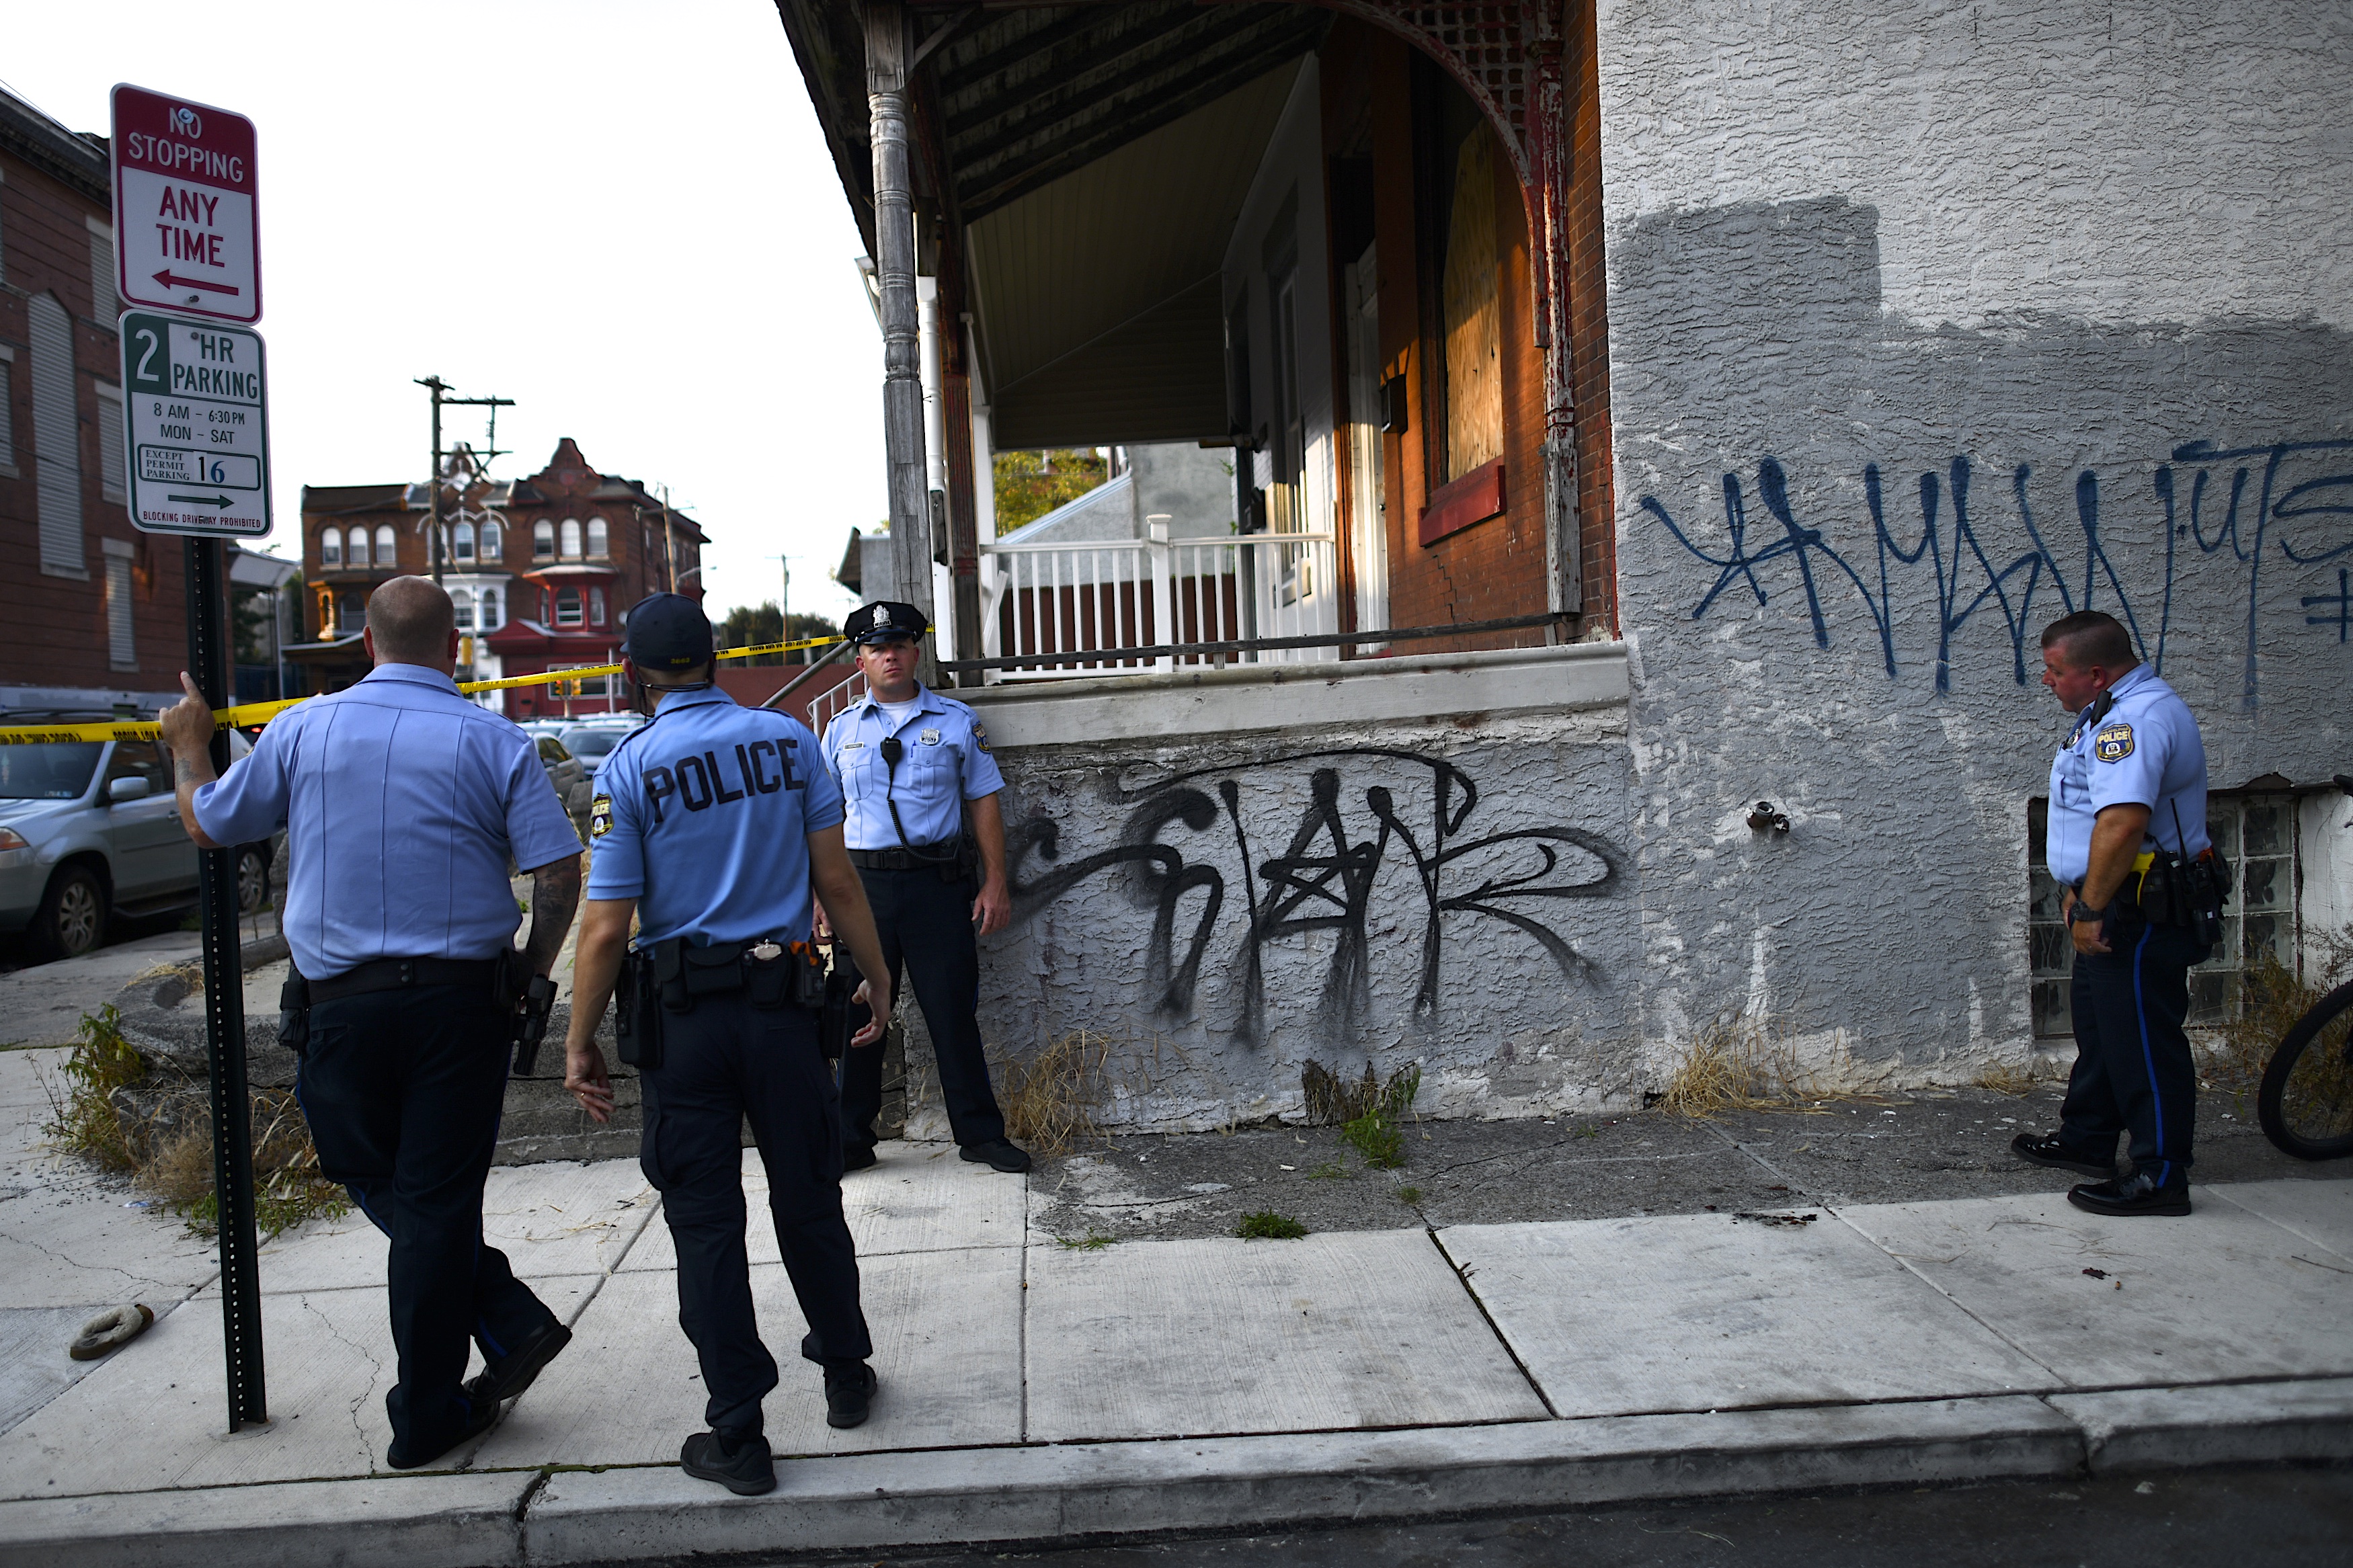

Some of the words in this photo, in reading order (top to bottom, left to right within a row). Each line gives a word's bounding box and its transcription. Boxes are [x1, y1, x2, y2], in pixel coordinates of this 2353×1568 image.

[169, 108, 202, 139] NO
[128, 132, 243, 183] STOPPING
[159, 185, 219, 226] ANY
[155, 223, 225, 267] TIME
[135, 329, 160, 382] 2
[201, 334, 234, 364] HR
[173, 363, 257, 399] PARKING
[154, 403, 162, 417] 8
[168, 405, 189, 420] AM
[161, 424, 192, 440] MON
[210, 429, 235, 444] SAT
[146, 450, 184, 461] EXCEPT
[146, 460, 185, 470] PERMIT
[146, 469, 190, 481] PARKING
[198, 456, 225, 483] 16
[143, 511, 178, 522] BLOCKING
[182, 514, 216, 525] DRIVEAY
[220, 517, 260, 528] PROHIBITED
[2098, 731, 2128, 744] POLICE
[641, 739, 805, 824] POLICE
